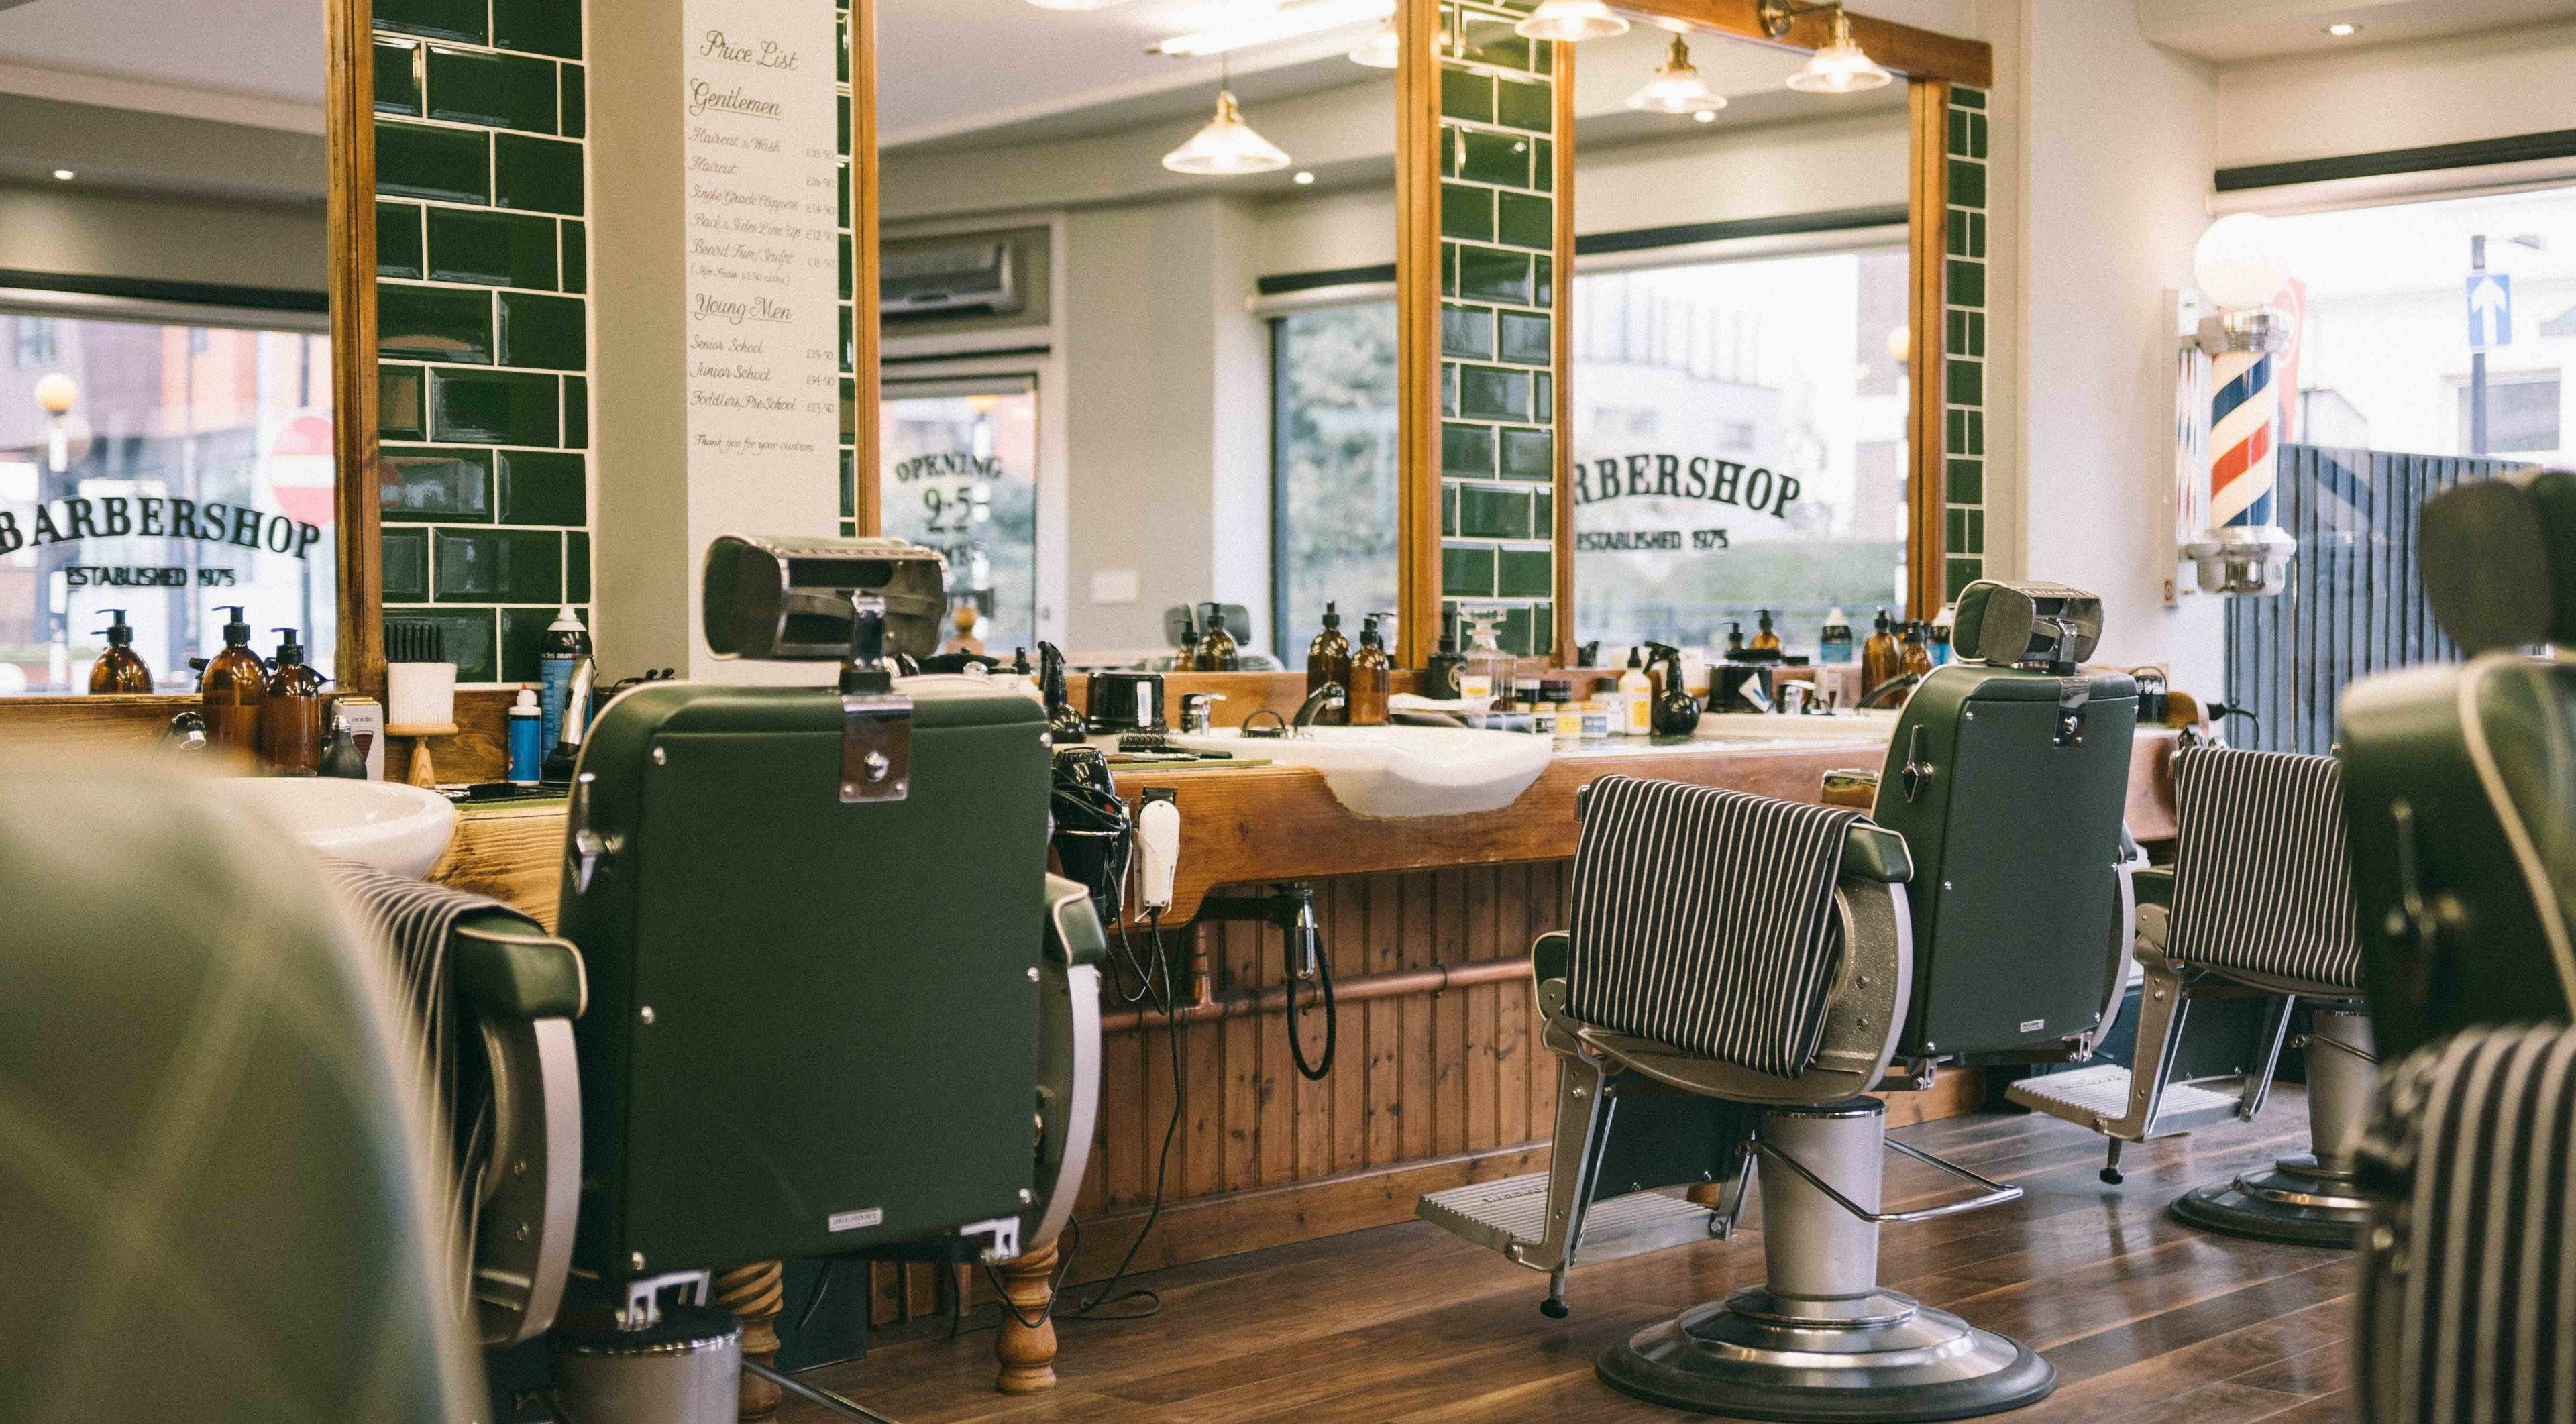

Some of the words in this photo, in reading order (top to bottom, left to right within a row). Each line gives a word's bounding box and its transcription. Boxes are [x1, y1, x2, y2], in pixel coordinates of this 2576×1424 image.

[700, 30, 752, 62] Price
[756, 40, 799, 70] List
[689, 78, 781, 116] Gentlemen
[688, 127, 738, 146] Haircut
[741, 140, 750, 149] &
[751, 136, 781, 152] Wash
[688, 156, 737, 175] Haircut
[688, 184, 722, 204] Single
[723, 190, 758, 206] Grade
[758, 195, 798, 214] Clippers
[690, 213, 720, 232] Back
[730, 217, 757, 233] Sides
[690, 239, 729, 258] Beard
[694, 293, 746, 324] Young
[749, 296, 792, 319] Men
[690, 334, 724, 350] Senior
[728, 337, 763, 354] School
[689, 362, 731, 378] Junior
[734, 364, 771, 382] School
[694, 435, 722, 447] Thank
[720, 439, 741, 453] you
[738, 437, 756, 455] for
[753, 441, 778, 456] your
[895, 452, 1002, 482] OPENING
[1576, 454, 1801, 519] RBERSHOP
[0, 496, 321, 559] BARBERSHOP
[1577, 531, 1682, 550] ESTABLISHED
[1692, 529, 1729, 549] 1975
[66, 566, 187, 586] ESTABLISHED
[197, 568, 235, 587] 1975
